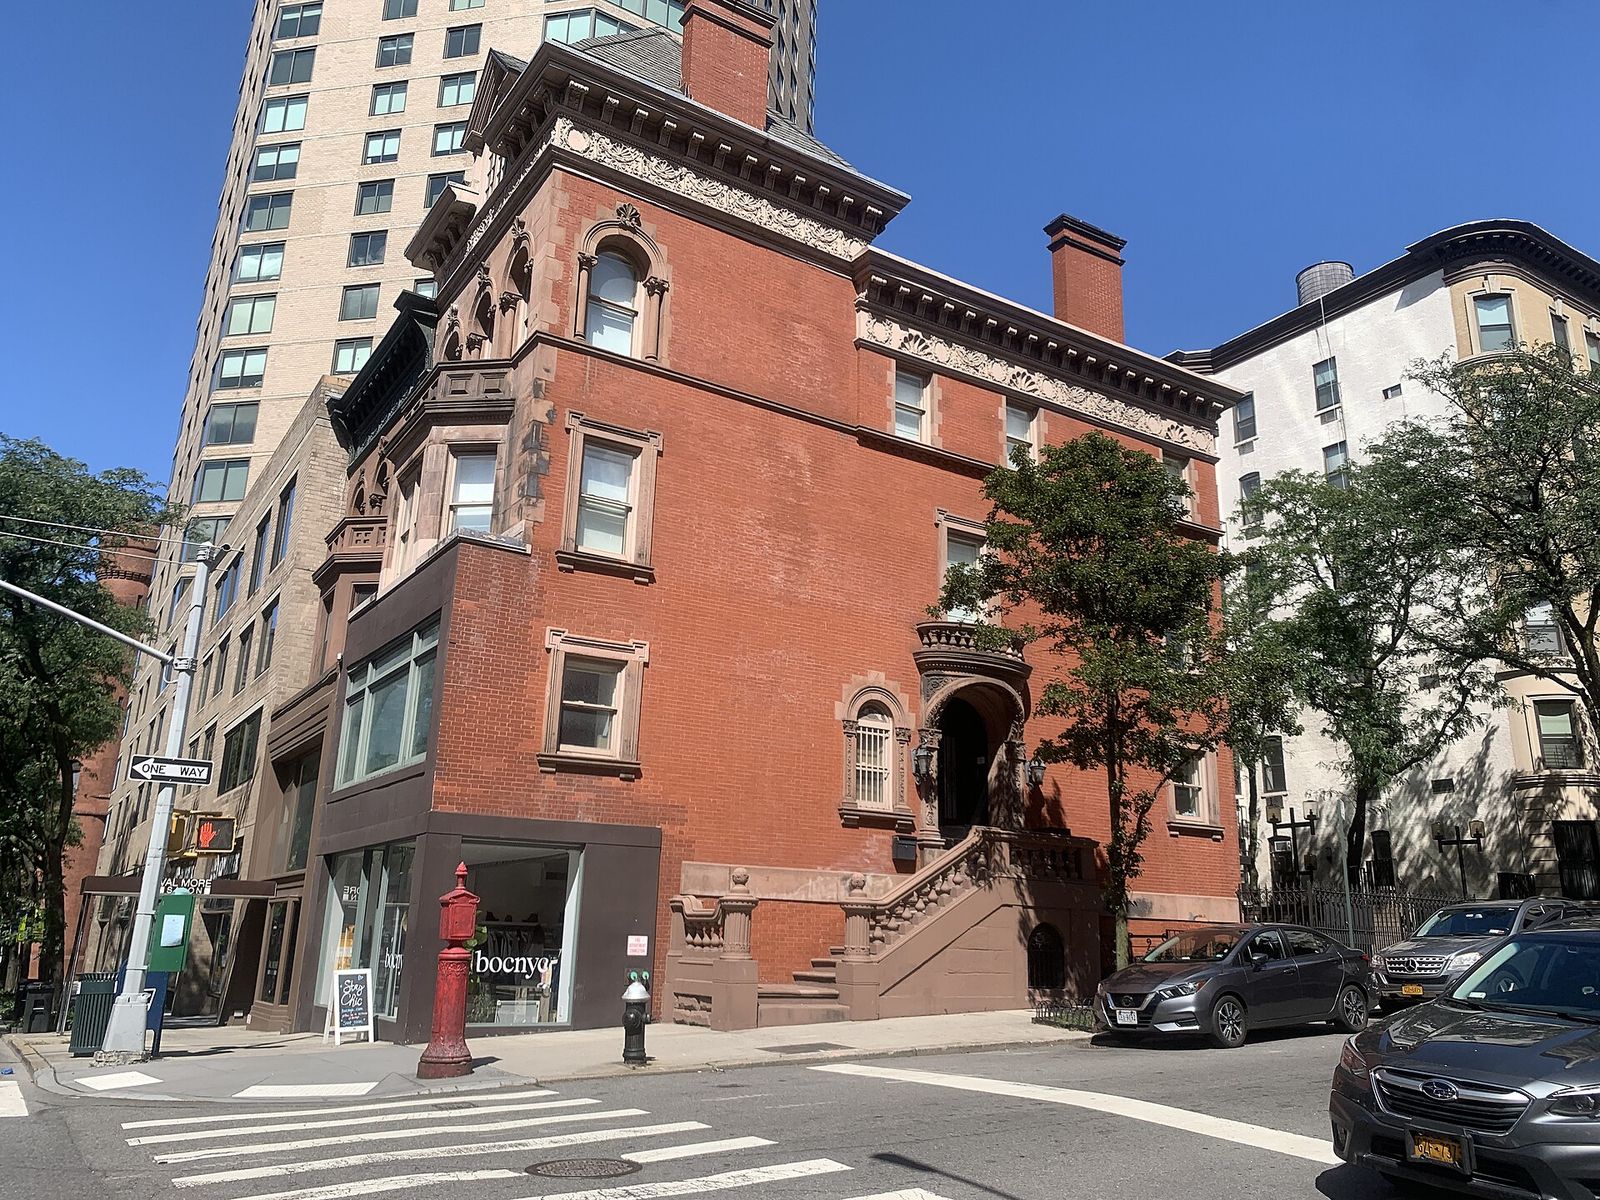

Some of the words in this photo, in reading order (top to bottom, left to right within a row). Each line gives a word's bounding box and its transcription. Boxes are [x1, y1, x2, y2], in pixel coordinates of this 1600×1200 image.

[142, 764, 166, 774] ONE
[180, 766, 205, 777] WAY
[181, 879, 211, 888] MORE
[167, 886, 203, 895] SON
[341, 993, 363, 1008] Chic
